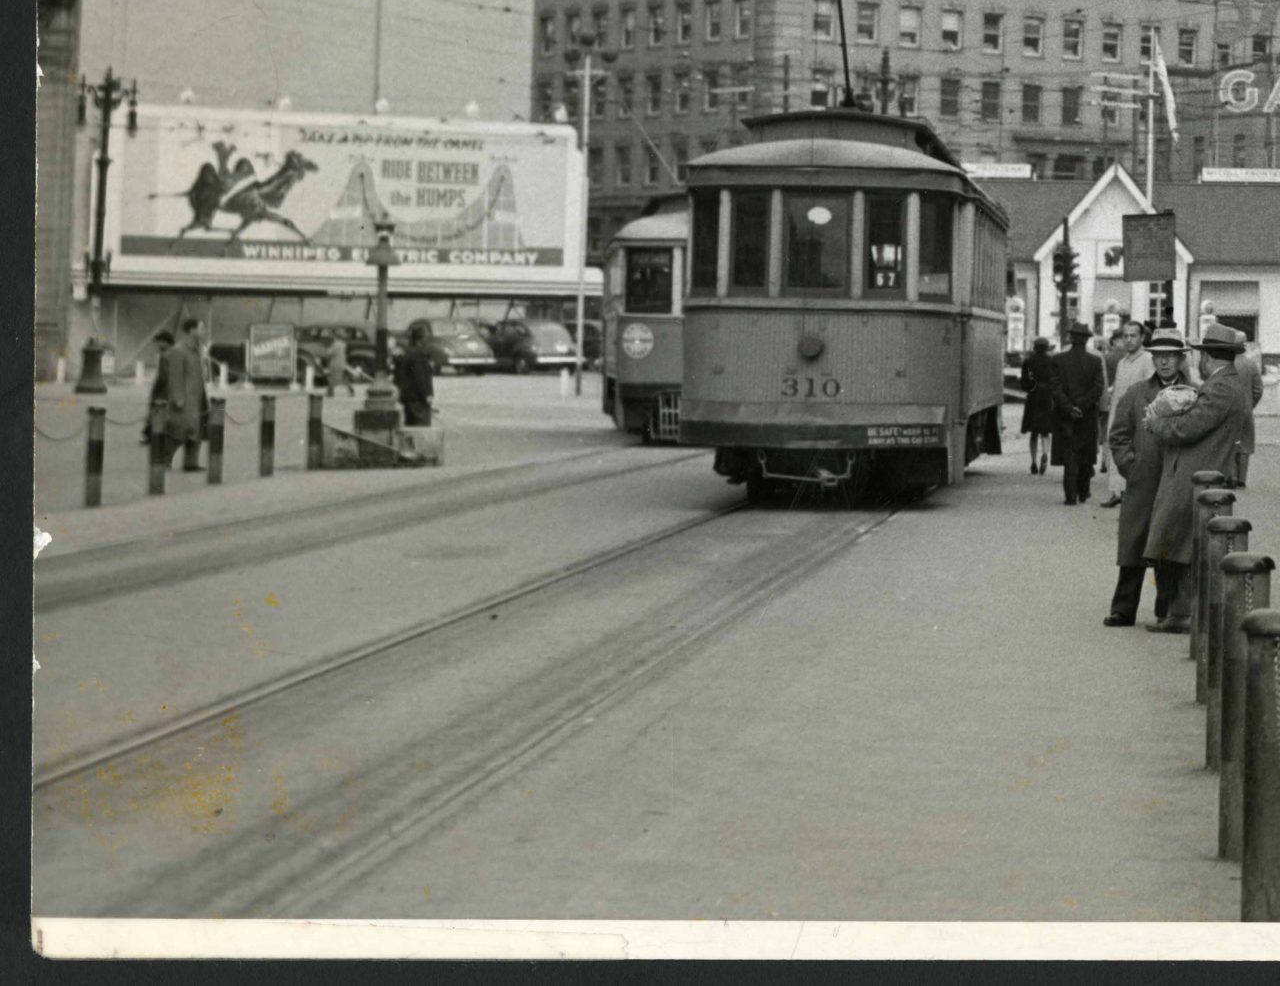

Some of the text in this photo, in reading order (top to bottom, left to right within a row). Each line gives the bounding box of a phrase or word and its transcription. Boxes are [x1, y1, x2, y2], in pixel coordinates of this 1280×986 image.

[382, 159, 479, 185] RIDE BETWEEN
[391, 188, 467, 209] the HUMPS
[242, 244, 539, 265] WINNIPEG ETRIC COMPANY
[780, 376, 842, 398] 310
